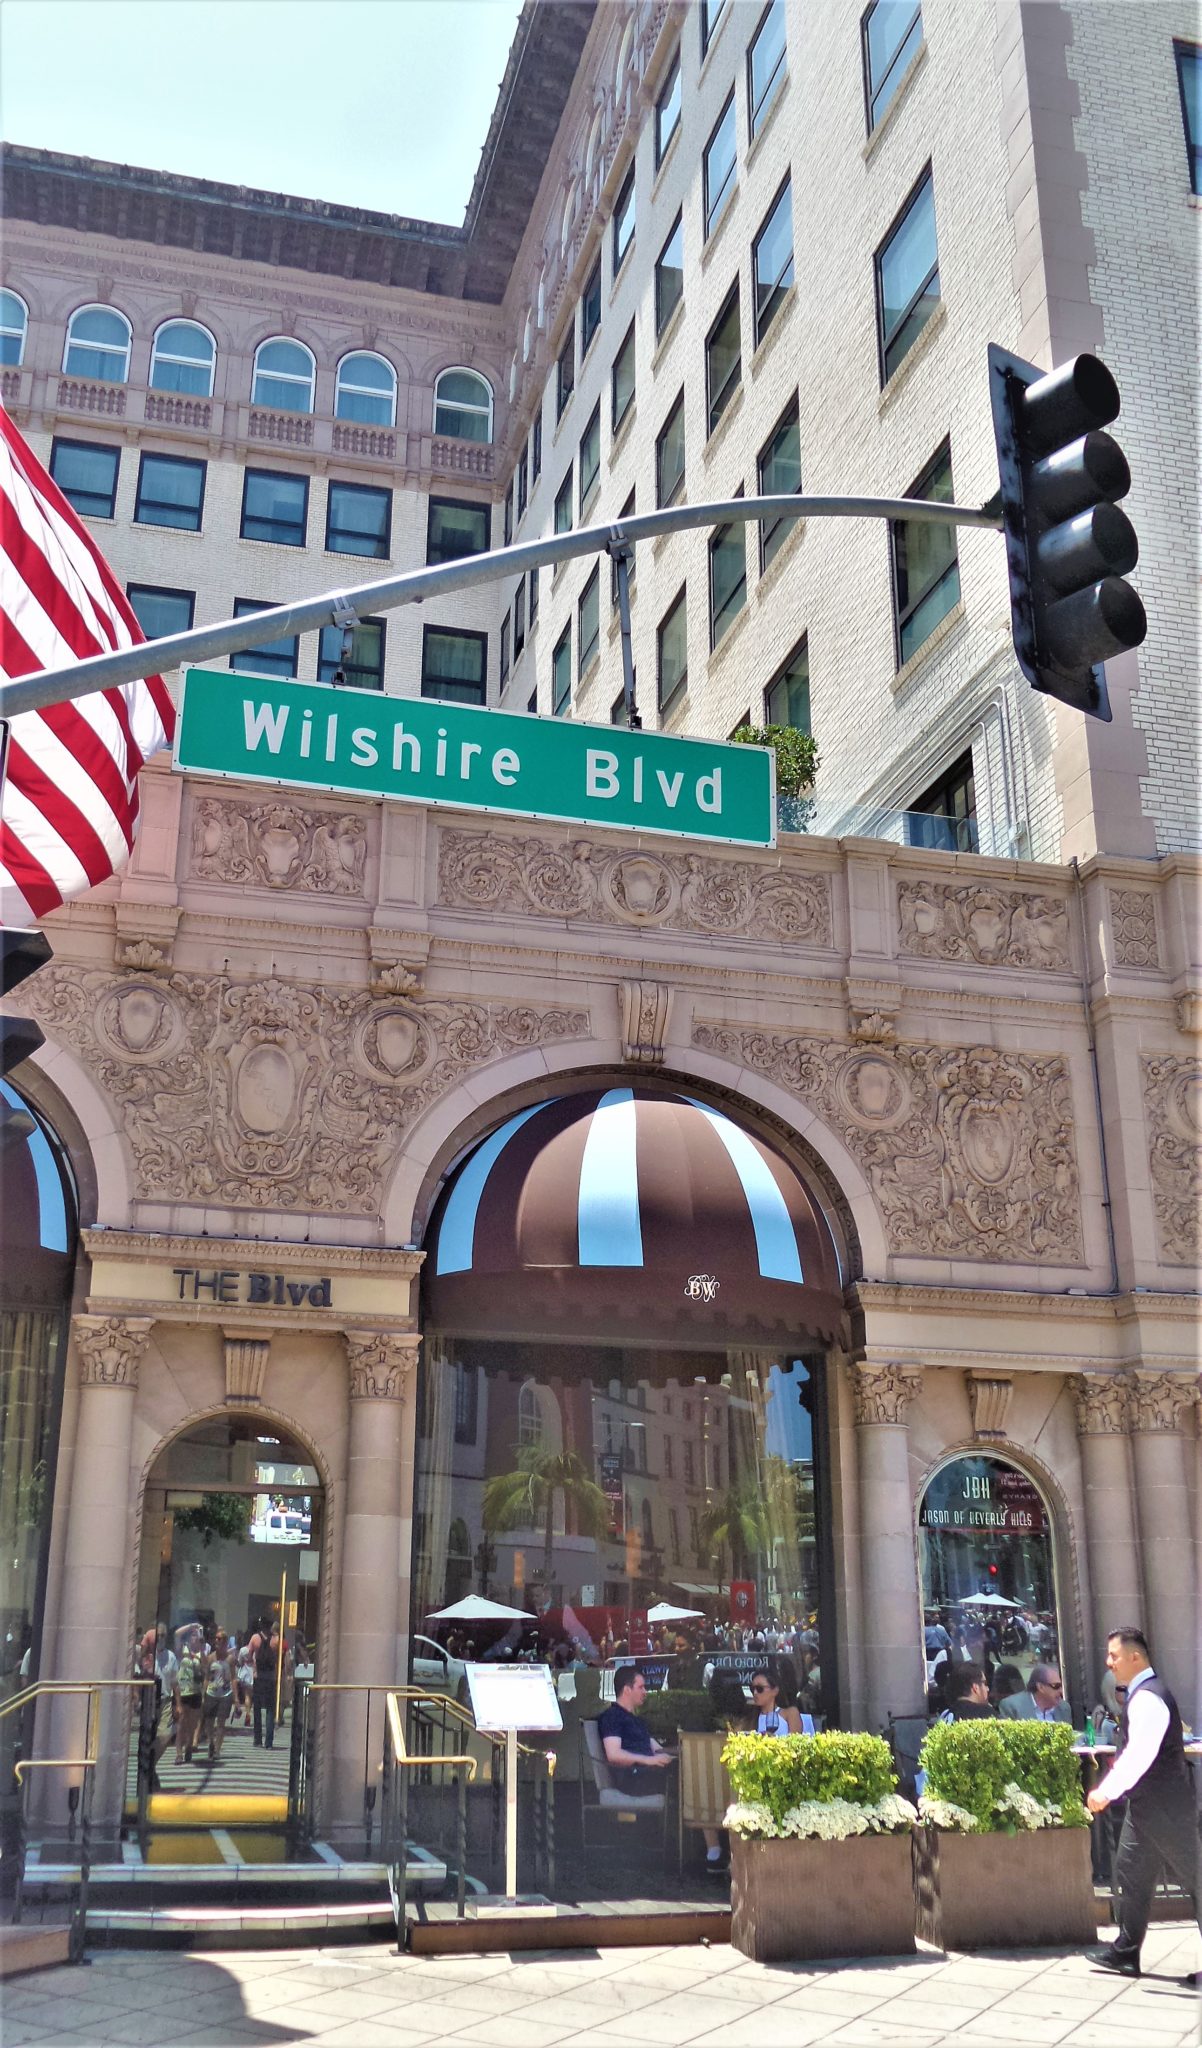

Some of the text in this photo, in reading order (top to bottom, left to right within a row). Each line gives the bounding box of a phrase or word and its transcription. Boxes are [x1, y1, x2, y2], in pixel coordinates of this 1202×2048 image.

[242, 699, 724, 815] Wilshire Blvd
[173, 1268, 333, 1308] THE Blvd
[962, 1476, 990, 1499] JBH
[922, 1510, 1032, 1527] JASON OF BEVERLY HILLS
